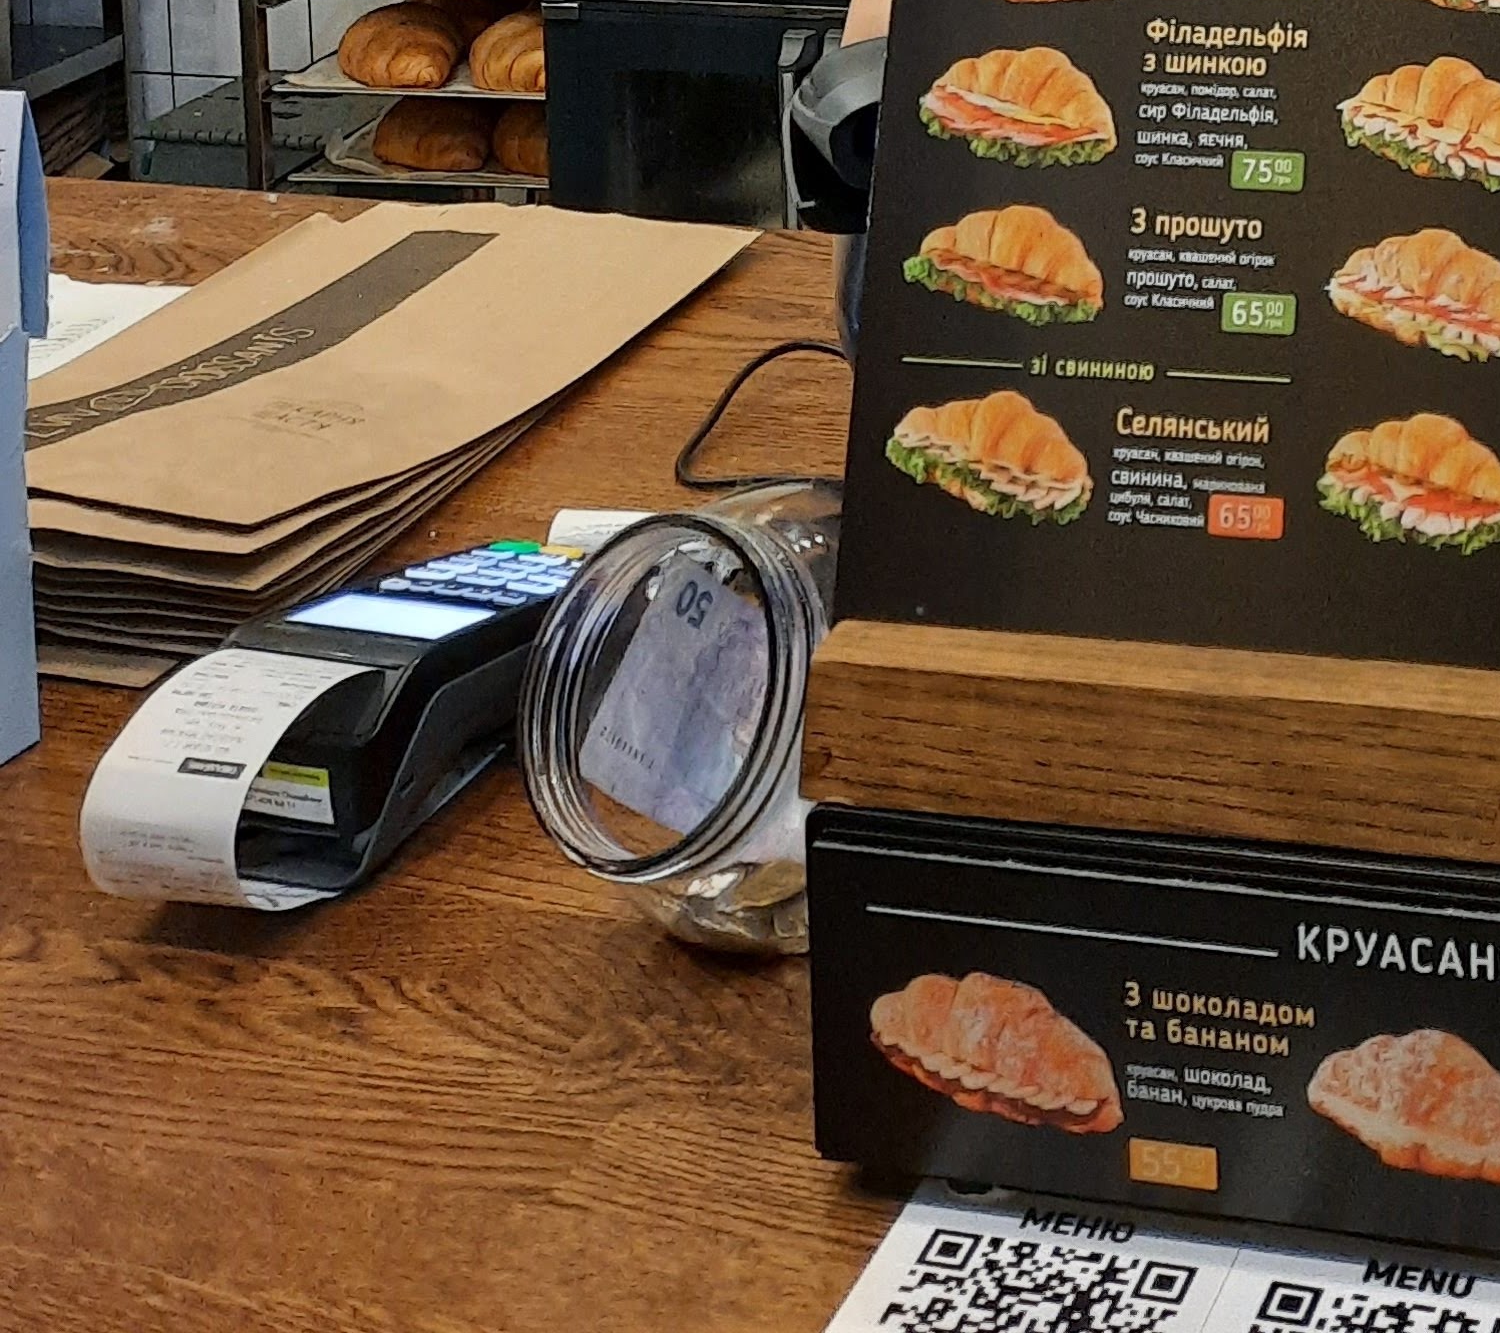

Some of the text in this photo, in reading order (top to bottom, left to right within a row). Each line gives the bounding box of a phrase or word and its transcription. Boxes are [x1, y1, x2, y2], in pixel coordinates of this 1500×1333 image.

[1146, 17, 1308, 54] Філадельфія
[1165, 54, 1267, 76] шинкою
[1155, 215, 1262, 244] прошуто
[1030, 353, 1155, 381] зі свининою
[1116, 406, 1270, 444] Селянський
[675, 579, 714, 630] 50
[1152, 989, 1315, 1030] шоколадом
[1166, 1020, 1289, 1057] бананом
[1018, 1205, 1138, 1244] МЕНЮ
[1361, 1257, 1478, 1299] MENU
